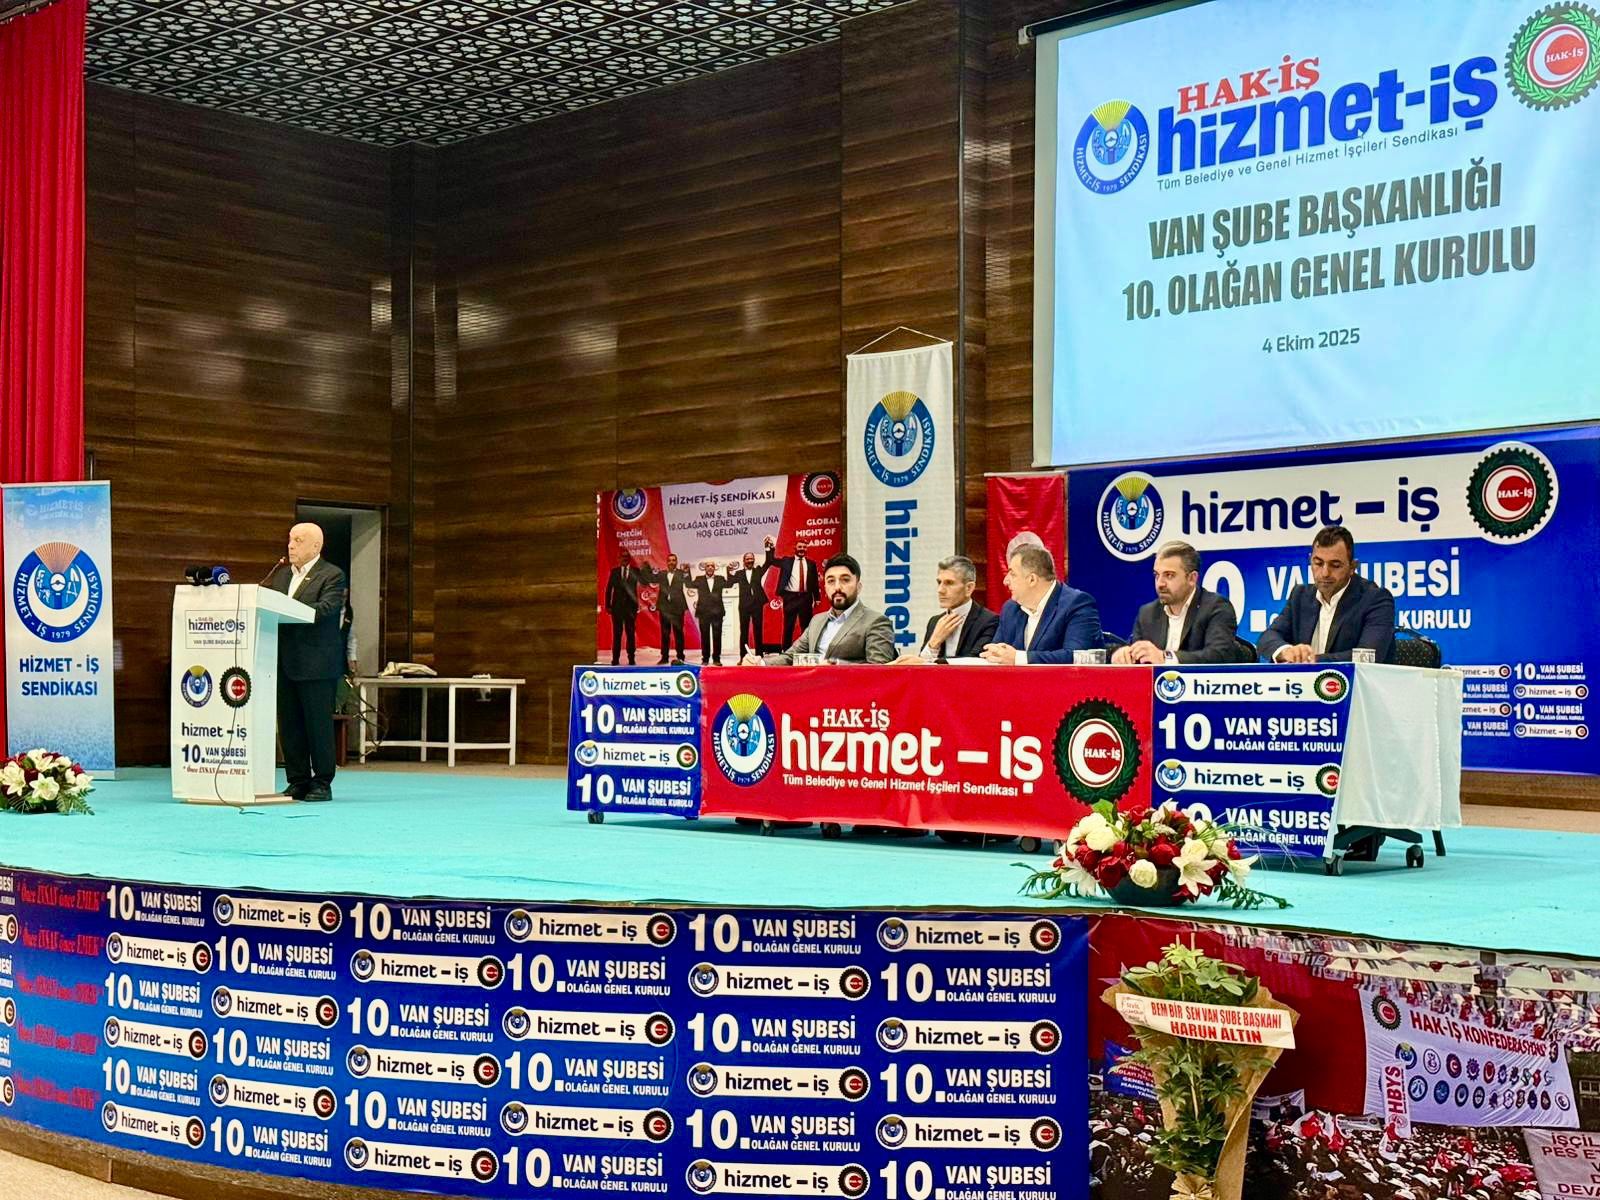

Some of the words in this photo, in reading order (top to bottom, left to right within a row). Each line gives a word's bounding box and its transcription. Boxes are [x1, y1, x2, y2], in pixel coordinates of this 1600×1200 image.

[1546, 48, 1584, 63] HAK-İŞ
[1177, 54, 1320, 115] HAK-İŞ
[1157, 56, 1497, 176] hizmet-iş
[1120, 134, 1147, 187] SENDİKASI
[1157, 177, 1182, 191] Tüm
[1184, 168, 1234, 188] Belediye
[1238, 167, 1253, 177] ve
[1256, 157, 1291, 175] Genel
[1296, 148, 1339, 165] Hizmet
[1344, 140, 1388, 159] İşçileri
[1392, 127, 1457, 148] Sendikası
[1149, 214, 1205, 260] VAN
[1213, 199, 1290, 259] ŞUBE
[1298, 156, 1502, 239] BAŞKANLIĞI
[1122, 280, 1161, 321] 10.
[1168, 261, 1282, 315] OLAĞAN
[1290, 248, 1385, 301] GENEL
[1394, 224, 1536, 286] KURULU
[1262, 338, 1273, 354] 4
[1276, 332, 1314, 352] Ekim
[1319, 327, 1360, 349] 2025
[867, 423, 879, 467] HİZMET
[894, 475, 909, 483] 1979
[911, 417, 929, 478] SENDİKASI
[721, 490, 775, 502] SENDİKASI
[1182, 488, 1343, 535] hizmet
[1398, 476, 1440, 532] iş
[1497, 487, 1533, 501] HAK-İŞ
[710, 519, 734, 527] GENEL
[736, 516, 779, 525] KURULUNA
[796, 529, 823, 537] MIGHT
[807, 518, 840, 526] GLOBAL
[1139, 508, 1162, 550] SENDİKASI
[696, 530, 711, 538] HOŞ
[884, 499, 918, 647] hizmet
[16, 572, 33, 620] HİZMET
[36, 623, 48, 636] İŞ
[52, 630, 71, 639] 1979
[74, 570, 100, 633] SENDİKASI
[1398, 609, 1471, 630] KURULU
[20, 658, 72, 672] HİZMET
[86, 654, 100, 675] İŞ
[1514, 663, 1540, 680] 10.
[1540, 665, 1555, 673] VAN
[1558, 662, 1584, 674] ŞUBESİ
[22, 678, 98, 696] SENDİKASI
[602, 672, 647, 691] hizmet
[659, 674, 671, 693] iş
[1193, 679, 1263, 695] hizmet
[1286, 679, 1303, 698] iş
[1466, 684, 1480, 692] VAN
[1482, 682, 1508, 692] ŞUBESİ
[580, 703, 623, 734] 10.
[622, 708, 646, 722] VAN
[648, 703, 691, 723] ŞUBESİ
[822, 701, 890, 731] HAK-İŞ
[1514, 703, 1540, 720] 10.
[1540, 705, 1554, 713] VAN
[1556, 703, 1582, 714] ŞUBESİ
[182, 722, 223, 738] hizmet
[237, 724, 247, 741] iş
[623, 724, 647, 734] OLAĞAN
[648, 725, 667, 735] GENEL
[669, 726, 695, 735] KURULU
[1158, 713, 1224, 751] 10.
[1224, 718, 1262, 736] VAN
[1268, 712, 1338, 740] ŞUBESİ
[182, 744, 205, 763] 10.
[205, 747, 219, 756] VAN
[751, 734, 774, 781] SENDİKASI
[781, 712, 944, 777] hizmet
[1000, 720, 1043, 794] iş
[1084, 747, 1121, 761] HAK-İŞ
[1226, 738, 1265, 751] OLAĞAN
[1268, 741, 1299, 752] GENEL
[1302, 740, 1343, 753] KURULU
[576, 773, 623, 805] 10.
[622, 780, 646, 794] VAN
[648, 777, 691, 797] ŞUBESİ
[782, 774, 803, 786] Tüm
[806, 774, 845, 789] Belediye
[847, 778, 858, 788] ve
[861, 777, 887, 790] Genel
[889, 778, 926, 792] Hizmet
[927, 777, 960, 795] İşçileri
[963, 782, 1018, 797] Sendikası
[106, 885, 141, 921] 10.
[140, 891, 161, 912] VAN
[164, 890, 202, 918] ŞUBESİ
[350, 901, 401, 941] 10.
[401, 908, 433, 928] VAN
[435, 906, 491, 933] ŞUBESİ
[539, 919, 603, 937] hizmet
[622, 921, 638, 942] iş
[688, 913, 752, 953] 10.
[752, 919, 788, 937] VAN
[792, 914, 857, 944] ŞUBESİ
[401, 930, 432, 942] OLAĞAN
[433, 932, 461, 943] GENEL
[463, 933, 496, 945] KURULU
[1151, 1002, 1168, 1016] BEM
[1169, 1002, 1182, 1019] BİR
[1186, 1006, 1201, 1020] SEN
[1202, 1008, 1218, 1022] VAN
[1220, 1009, 1241, 1026] ŞUBE
[1170, 1021, 1217, 1039] HARUN
[1221, 1028, 1262, 1043] ALTIN
[1409, 1010, 1462, 1043] HAK-İŞ
[879, 1063, 946, 1103] 10.
[945, 1068, 982, 1087] VAN
[986, 1063, 1051, 1094] ŞUBESİ
[1385, 1066, 1403, 1113] HBYS
[1542, 1147, 1578, 1158] PES
[503, 1146, 562, 1188] 10.
[562, 1153, 596, 1173] VAN
[600, 1152, 663, 1180] ŞUBESİ
